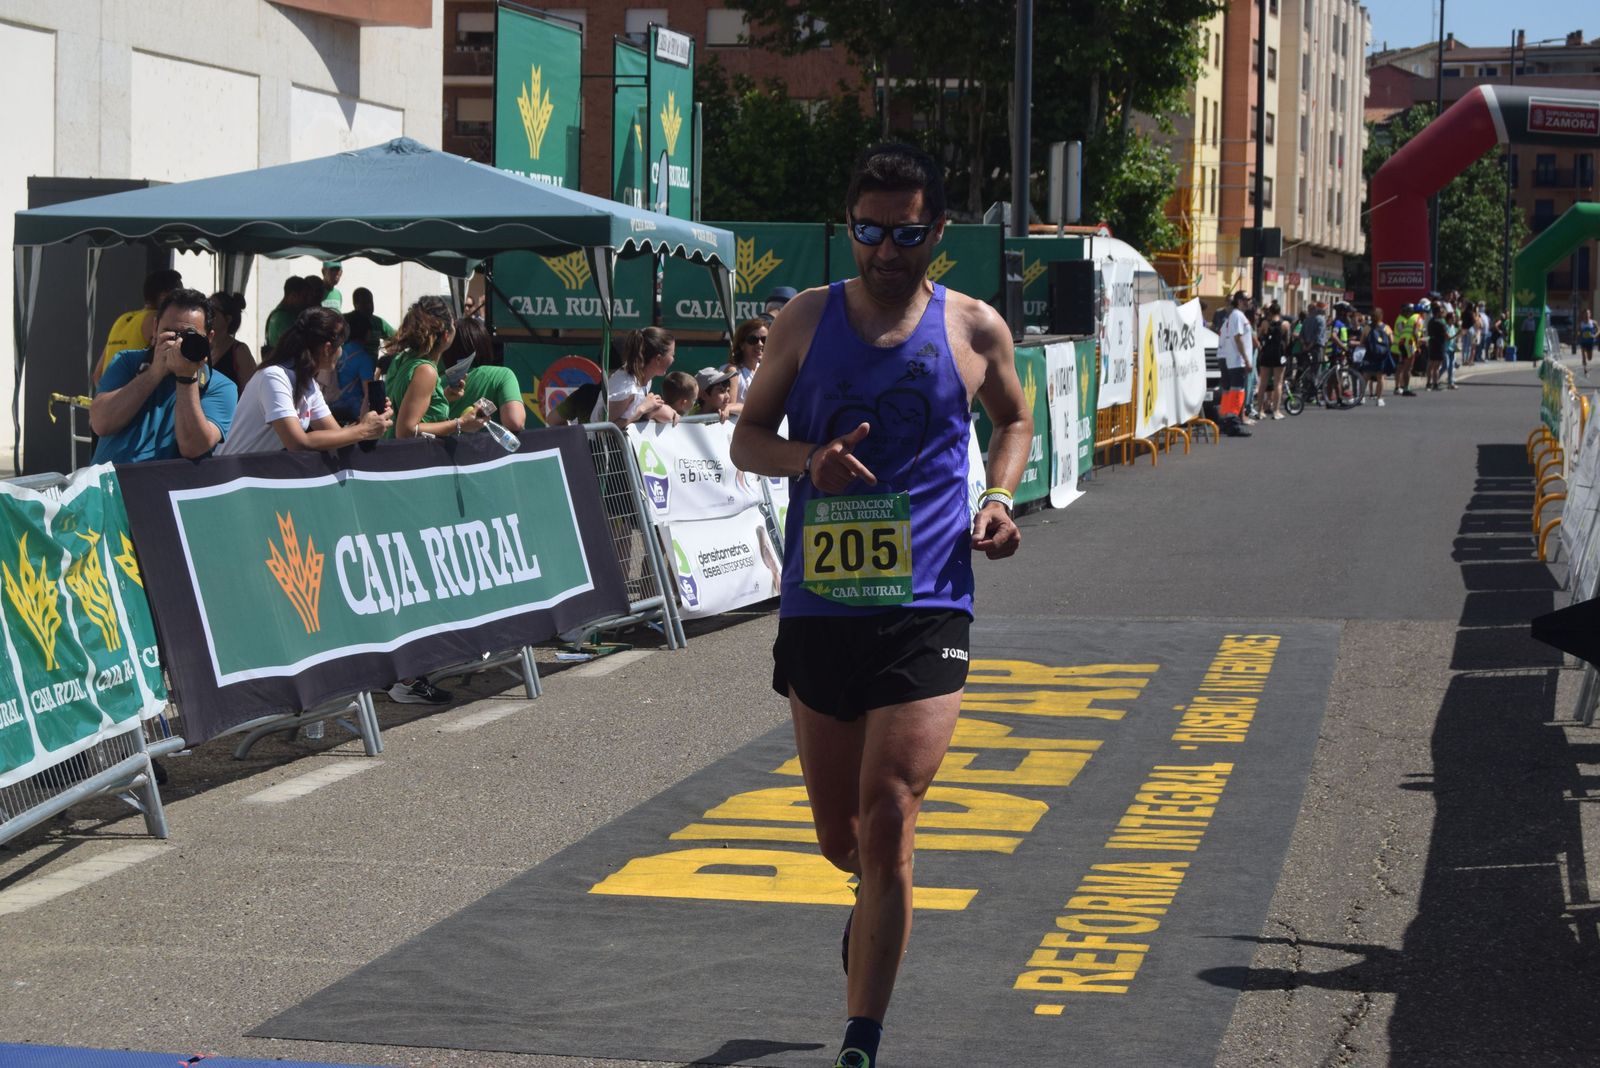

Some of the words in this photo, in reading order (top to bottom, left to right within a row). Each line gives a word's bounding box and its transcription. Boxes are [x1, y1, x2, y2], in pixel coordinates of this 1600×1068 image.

[1545, 117, 1595, 129] ZAMORA
[509, 296, 558, 317] CAJA
[565, 297, 640, 318] RUAL
[831, 512, 854, 521] CAJA
[857, 509, 894, 519] RURAL
[335, 531, 431, 616] CAJA
[419, 513, 542, 600] RURAL
[814, 528, 898, 574] 205
[832, 588, 860, 598] CAJA
[862, 585, 906, 597] RURAL
[1198, 634, 1282, 693] INTERIORES
[1171, 696, 1259, 743] DISEÑO
[1104, 762, 1235, 851] INTEGRAL
[1013, 861, 1191, 994] REFORMA
